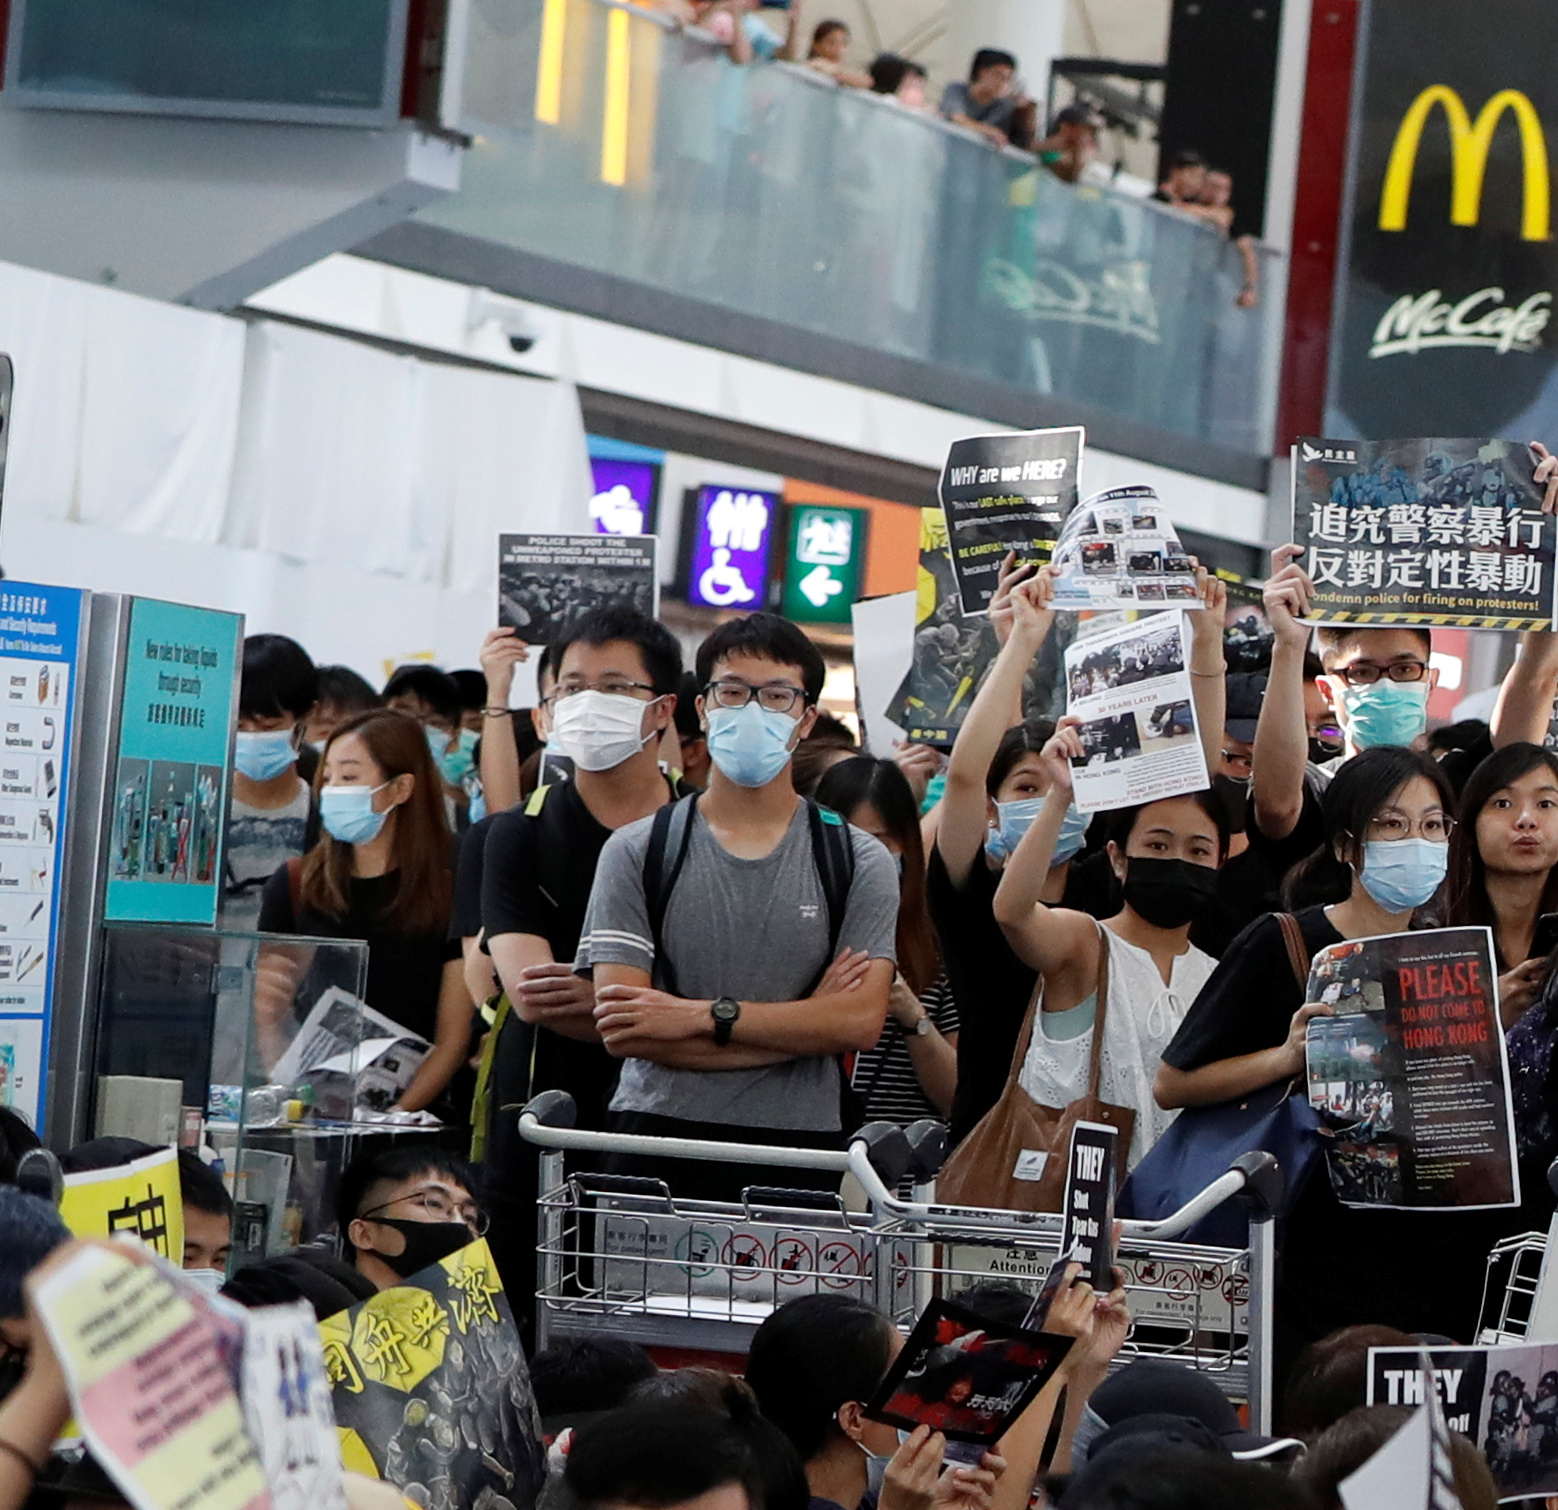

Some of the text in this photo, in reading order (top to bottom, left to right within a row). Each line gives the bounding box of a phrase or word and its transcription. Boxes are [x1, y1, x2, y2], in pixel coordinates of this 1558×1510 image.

[951, 459, 1067, 486] WHY are we HERE?
[1309, 502, 1545, 549] 追究警察暴行
[528, 536, 567, 546] POLICE
[1308, 546, 1543, 596] 反對定性暴動
[1313, 592, 1540, 612] ondemn police for firing on protesters!
[1108, 694, 1158, 711] YEARS LATER
[1399, 962, 1483, 1001] PLEASE
[1402, 999, 1486, 1023] DO NOT COME TO
[1403, 1021, 1489, 1049] HONG KONG
[1076, 1145, 1105, 1181] THEY
